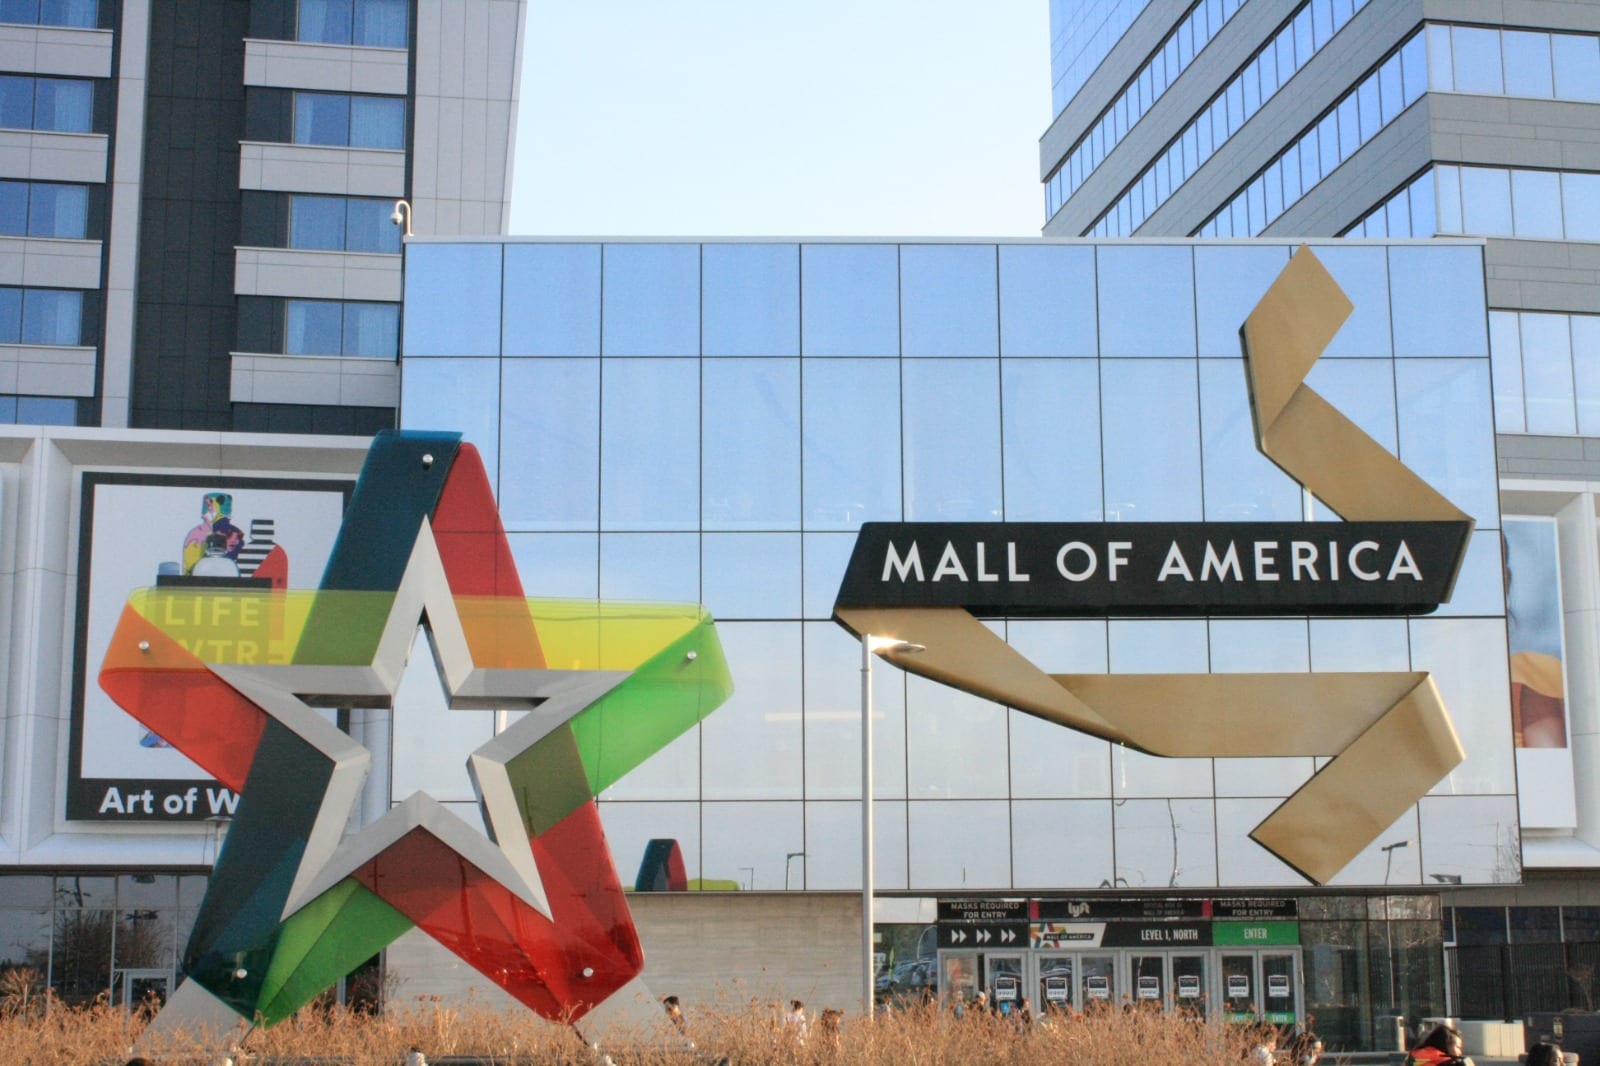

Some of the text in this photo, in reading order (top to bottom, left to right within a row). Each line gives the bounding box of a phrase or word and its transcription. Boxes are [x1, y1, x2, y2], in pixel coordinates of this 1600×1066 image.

[881, 540, 1423, 583] MALL OF AMERICA
[165, 596, 260, 626] LIFE
[99, 787, 154, 814] Art
[163, 787, 198, 814] of
[951, 902, 1020, 910] MASKS REQUIRED
[1141, 929, 1163, 940] LEVEL
[1173, 929, 1198, 940] NORTH
[1244, 928, 1267, 939] ENTER
